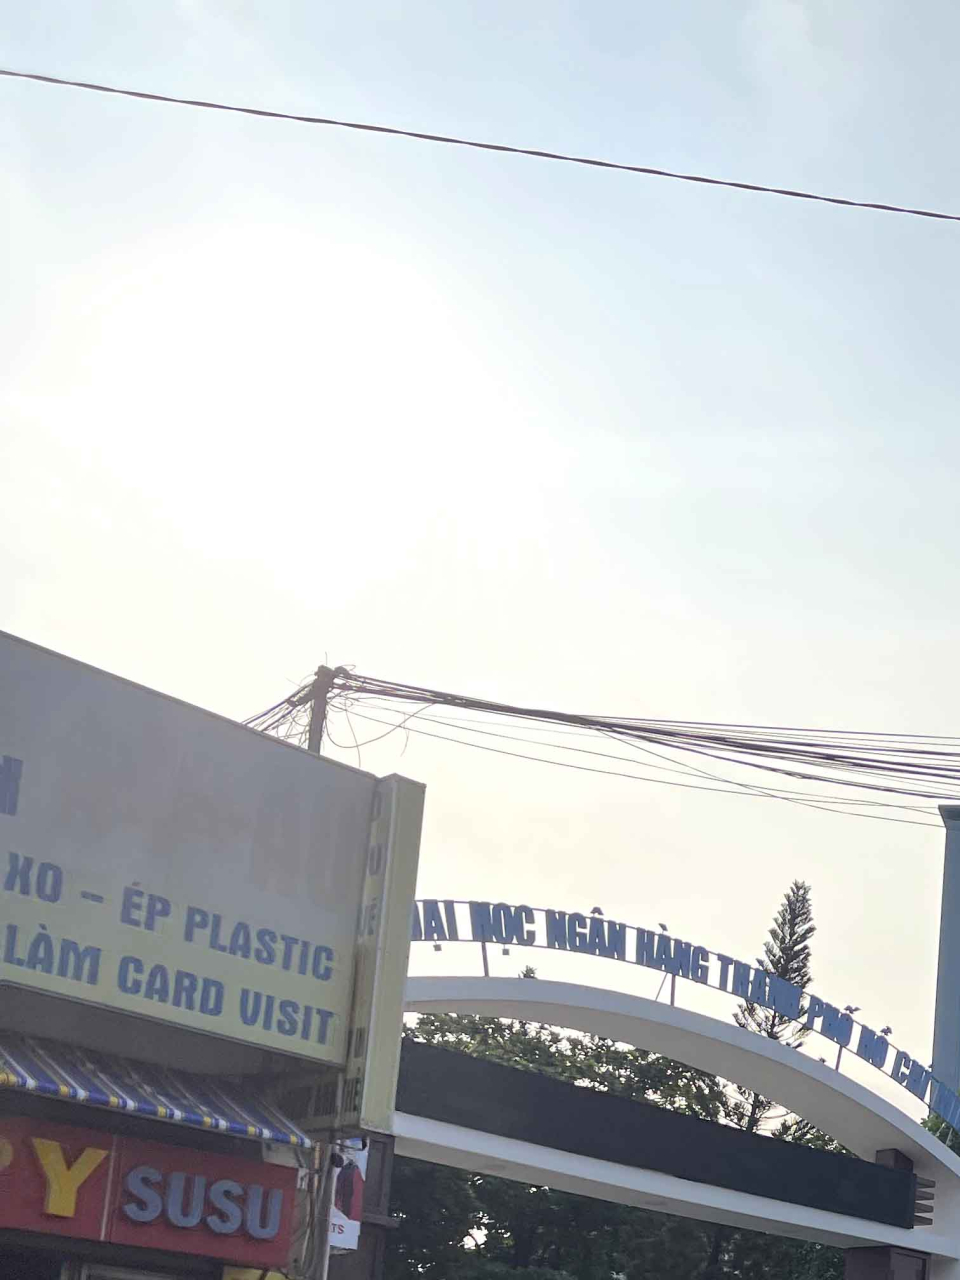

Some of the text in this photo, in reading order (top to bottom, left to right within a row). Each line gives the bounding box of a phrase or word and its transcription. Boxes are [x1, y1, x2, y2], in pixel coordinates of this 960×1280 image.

[4, 851, 63, 903] XO
[119, 882, 172, 932] ÉP
[183, 905, 335, 982] PLASTIC
[546, 906, 627, 962] NGÂN
[636, 922, 710, 985] HÀNG
[3, 923, 336, 1045] LÀM CARD VISIT
[122, 1165, 284, 1240] SUSU
